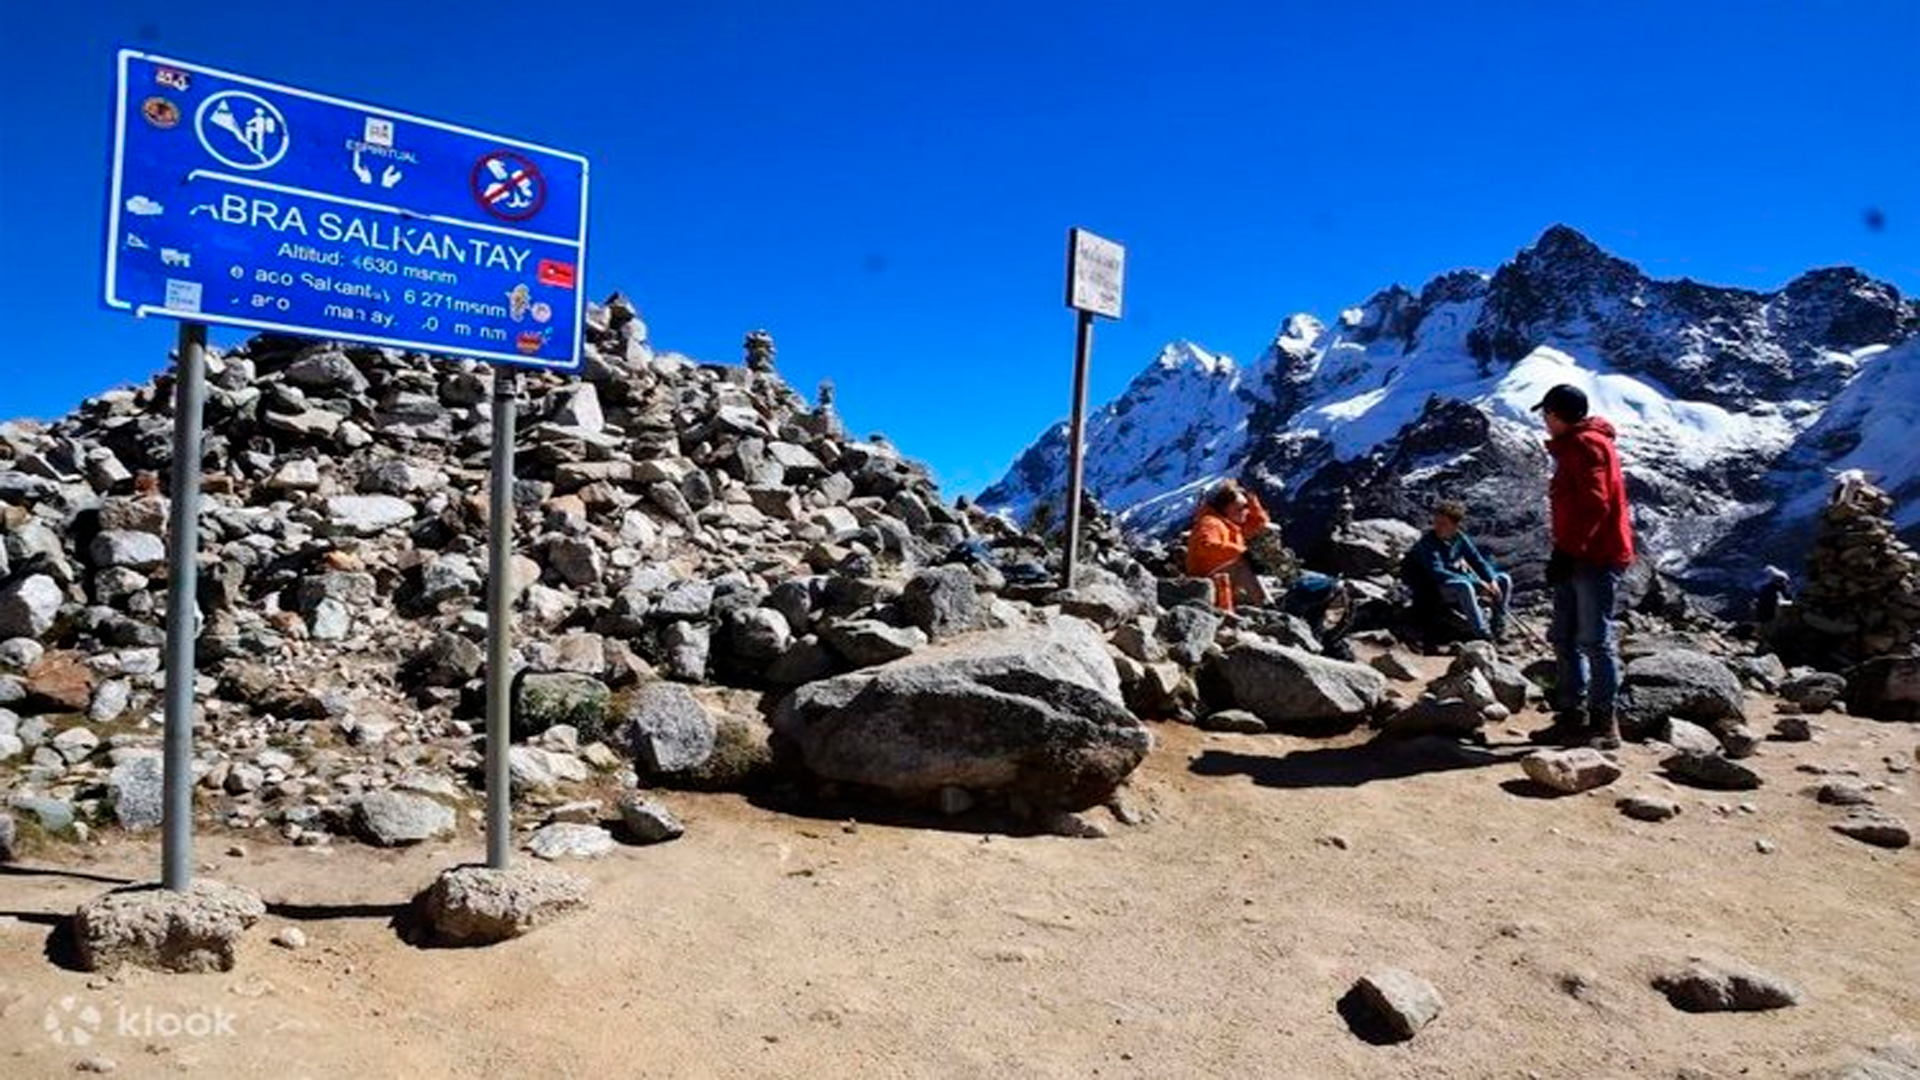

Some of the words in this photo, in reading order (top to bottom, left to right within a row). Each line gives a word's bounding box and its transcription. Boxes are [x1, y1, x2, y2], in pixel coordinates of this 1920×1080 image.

[277, 242, 345, 267] Altitud:
[403, 265, 457, 285] msnm
[317, 212, 531, 272] SALKANTAY
[454, 323, 507, 340] mnm
